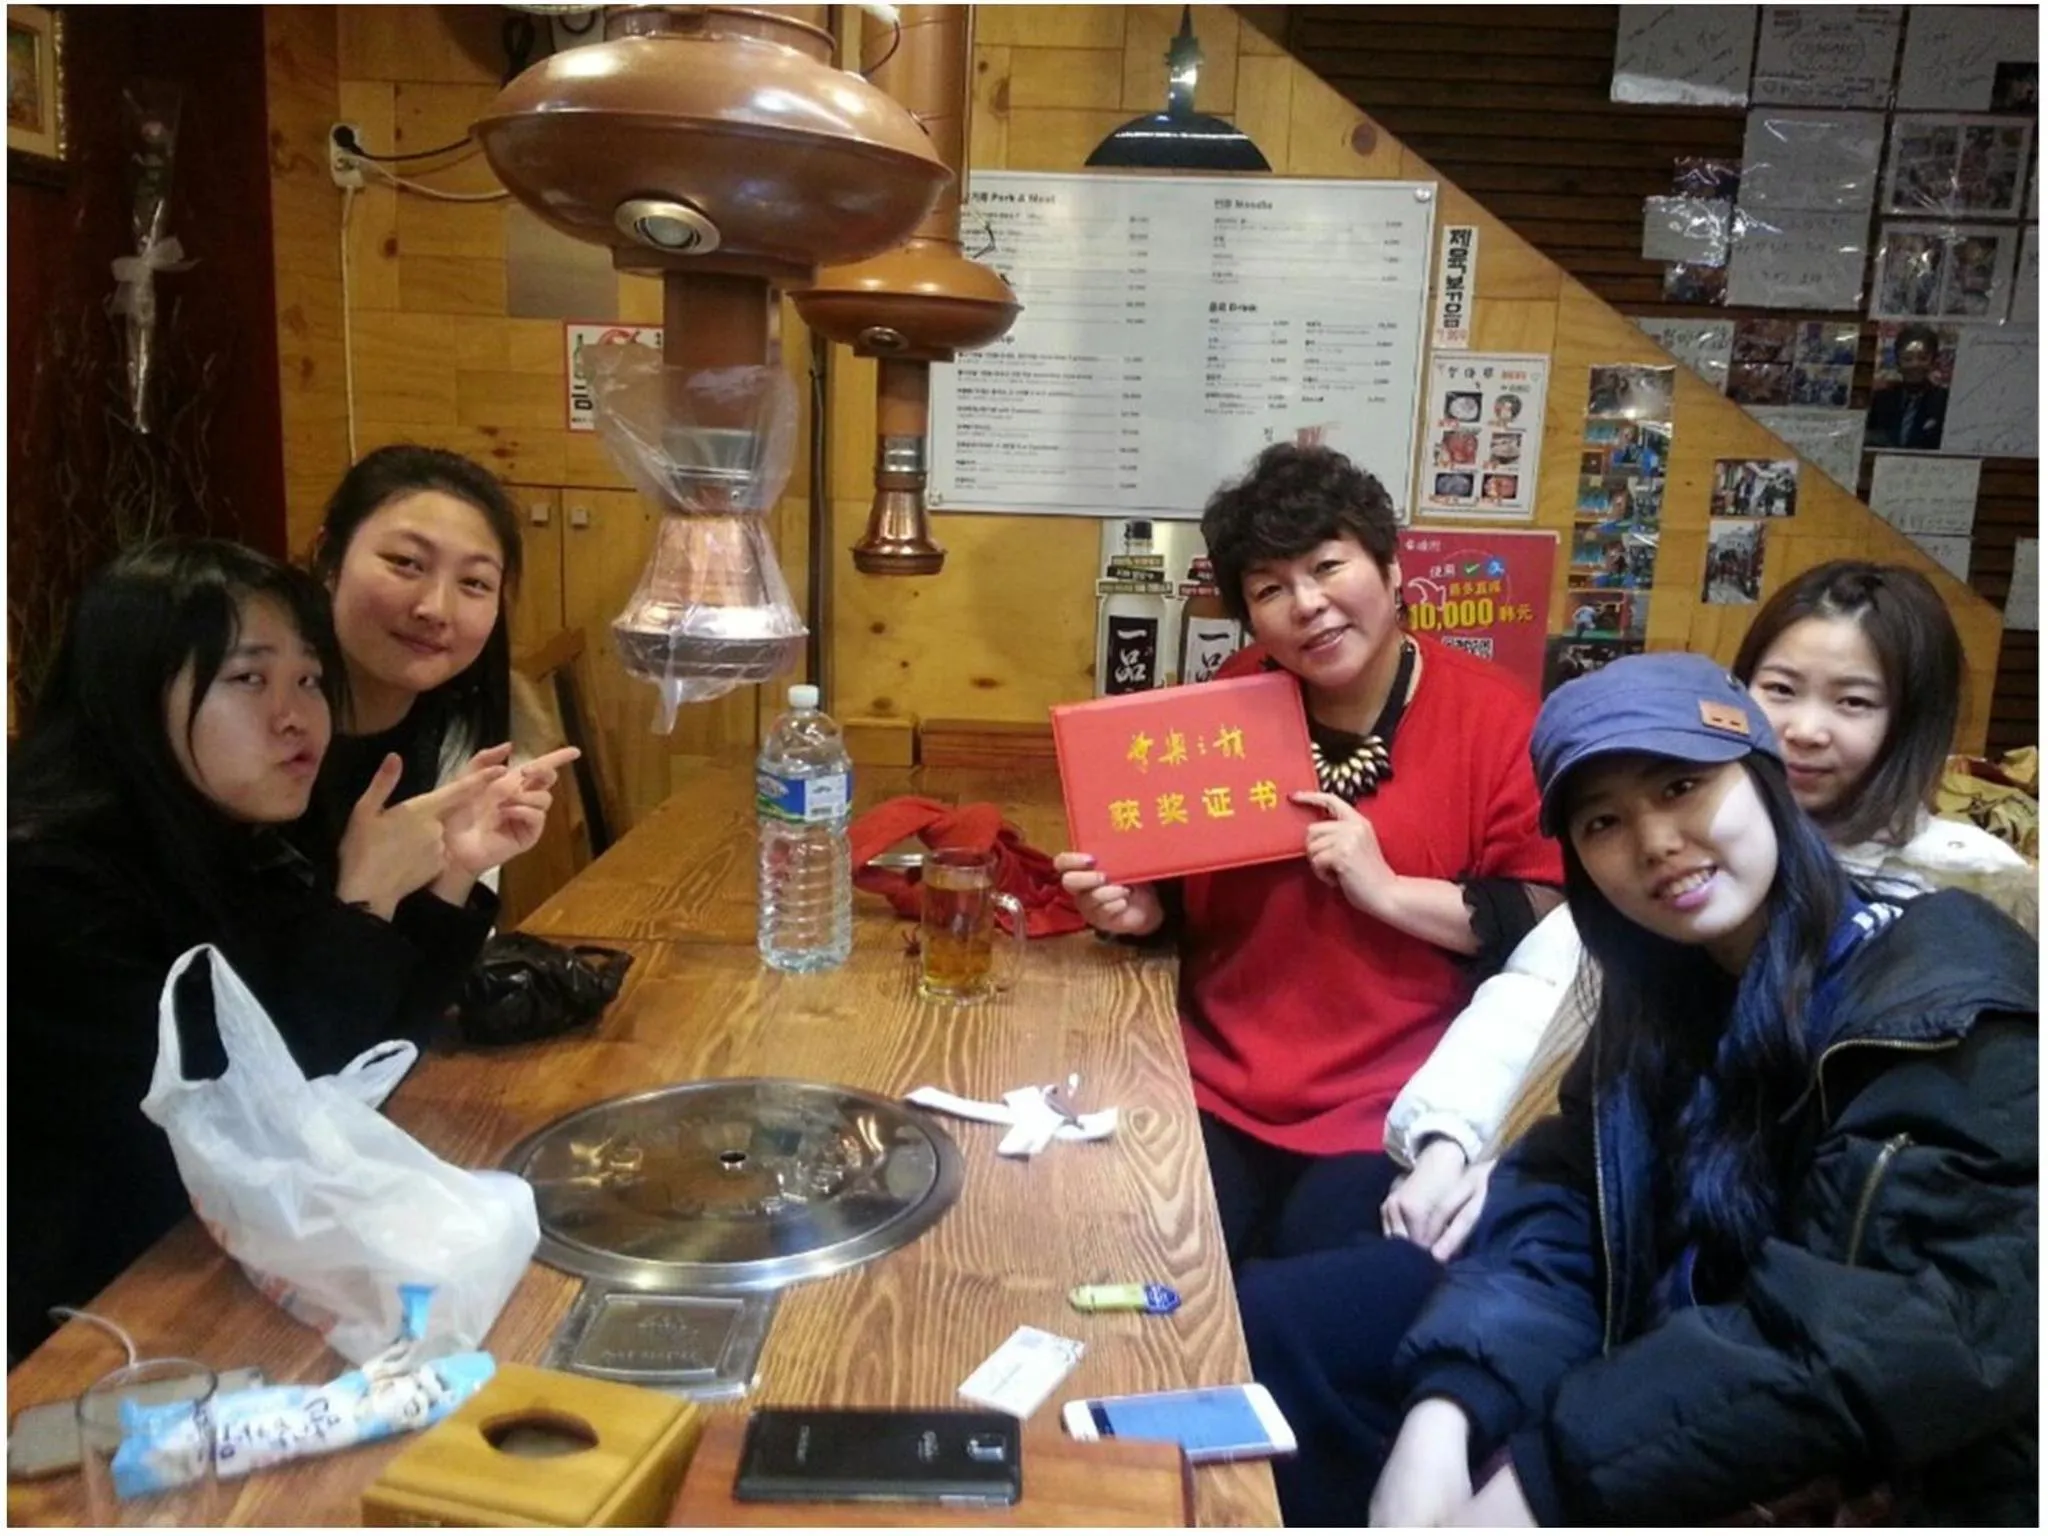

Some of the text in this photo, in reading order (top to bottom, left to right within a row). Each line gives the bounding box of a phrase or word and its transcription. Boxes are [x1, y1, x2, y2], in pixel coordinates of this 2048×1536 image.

[1442, 228, 1472, 329] 제육볶음
[1408, 597, 1495, 632] 10,000
[1107, 778, 1279, 833] 获奖证书
